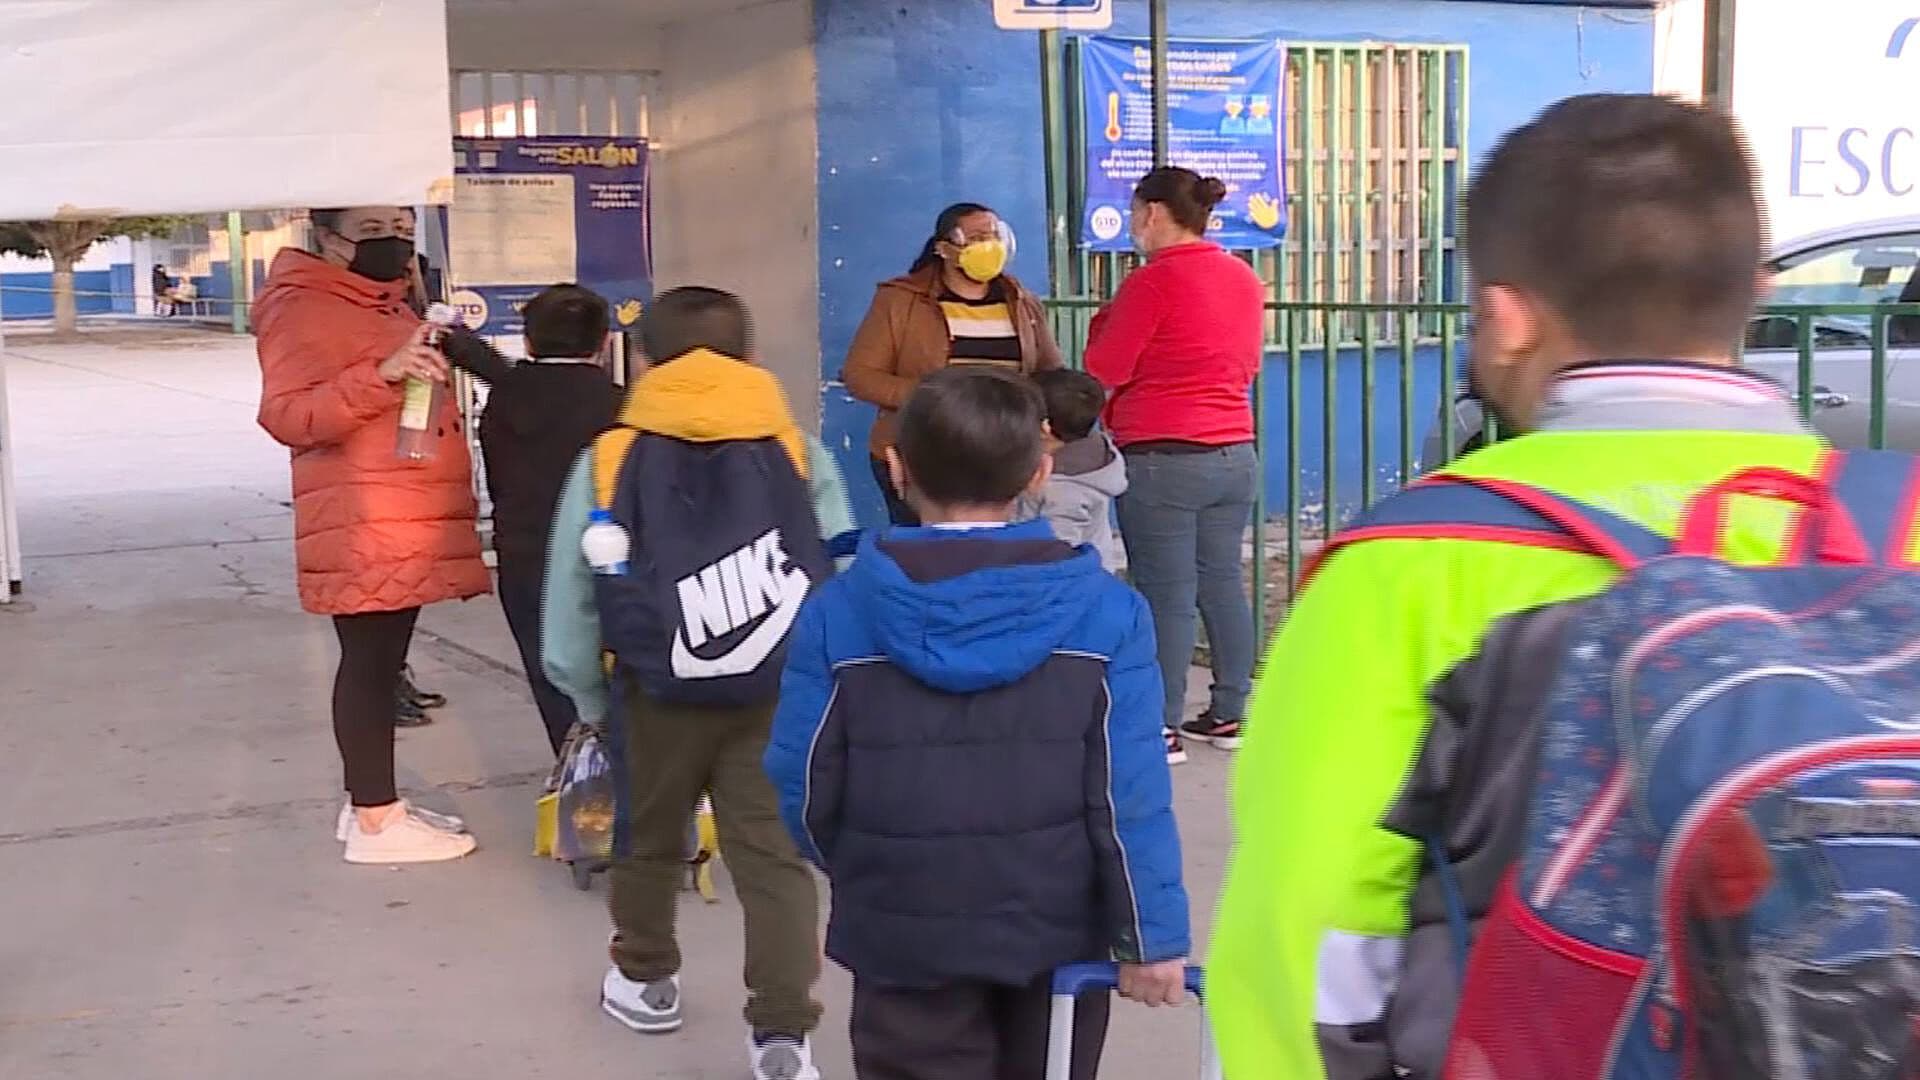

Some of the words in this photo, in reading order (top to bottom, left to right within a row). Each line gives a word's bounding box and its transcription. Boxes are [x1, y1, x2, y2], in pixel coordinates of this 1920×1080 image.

[557, 142, 638, 169] SALÓN
[1790, 126, 1914, 197] ESC
[677, 528, 795, 649] NIKE
